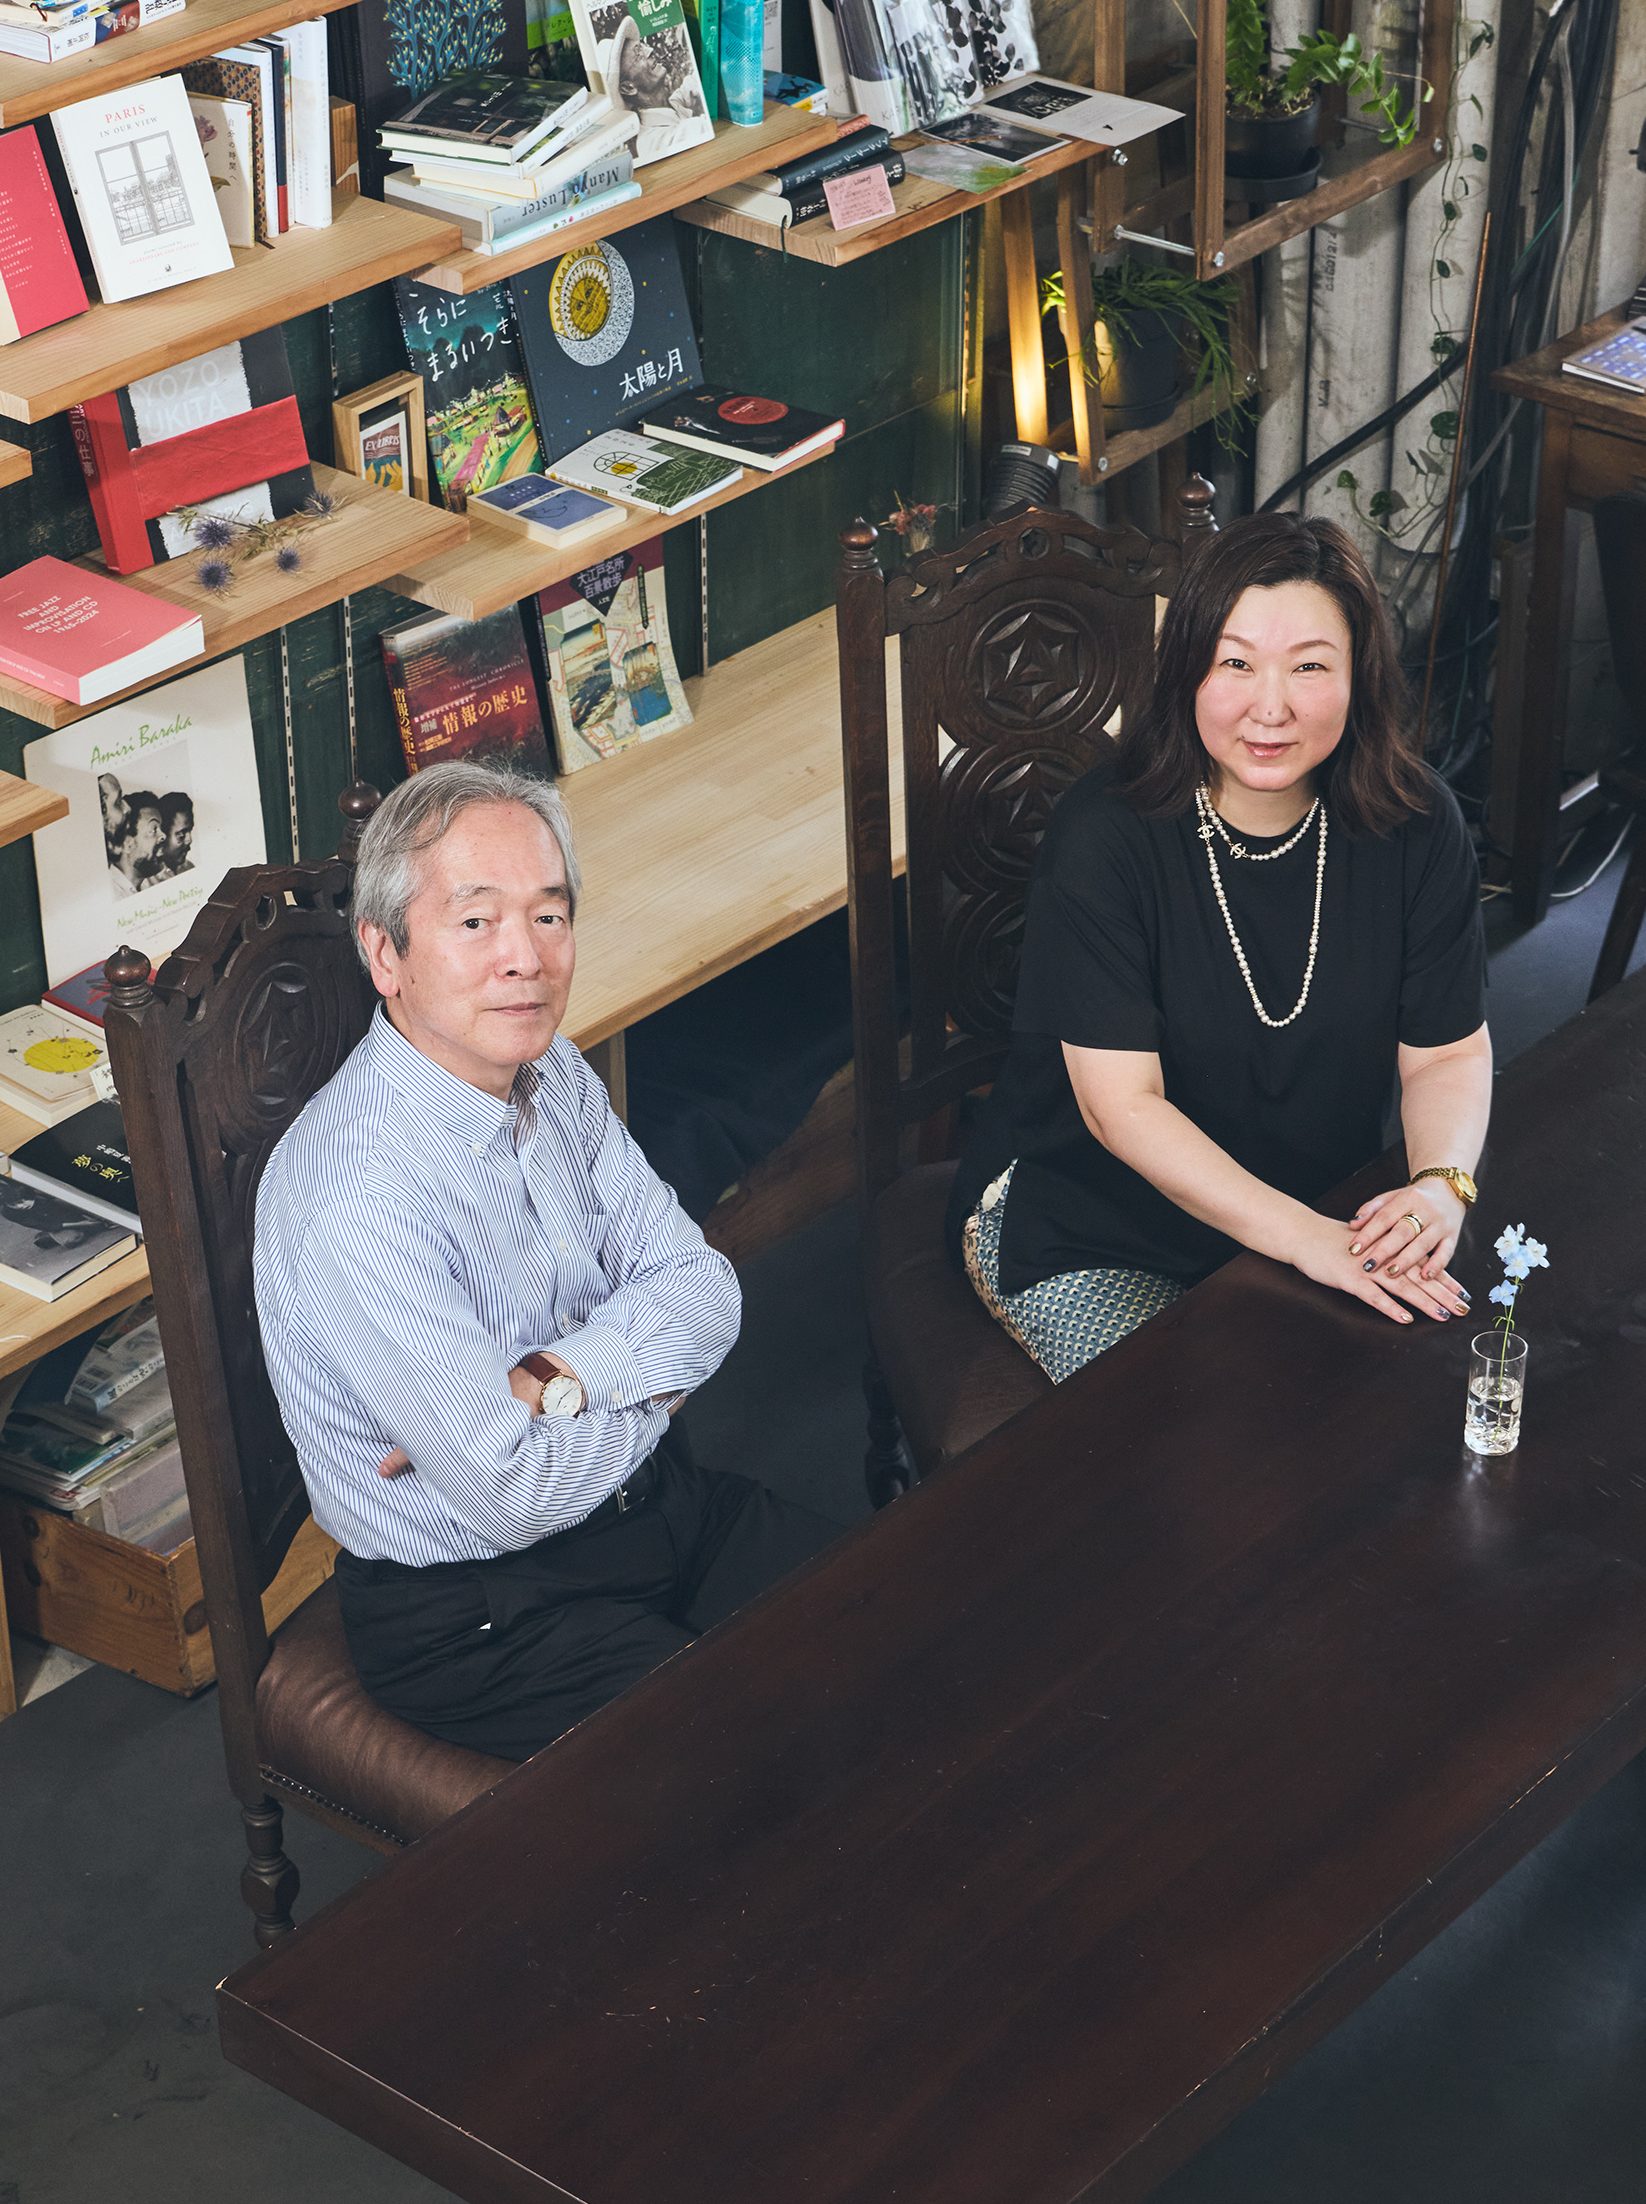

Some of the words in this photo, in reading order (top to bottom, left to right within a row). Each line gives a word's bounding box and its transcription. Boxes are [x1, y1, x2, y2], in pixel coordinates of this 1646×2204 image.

[99, 129, 110, 138] IN
[113, 123, 132, 134] OUR
[135, 116, 158, 127] VIEW
[104, 103, 146, 124] PARIS
[521, 188, 567, 217] Luster
[412, 296, 467, 335] そらに
[427, 316, 512, 382] まるいつき
[619, 347, 684, 401] 太陽と月
[365, 440, 377, 452] EX
[376, 434, 401, 449] LIBRIS
[576, 555, 625, 588] 大江戸名所
[23, 595, 92, 632] IMPROVISATION
[35, 625, 52, 634] ON
[63, 609, 83, 623] AND
[82, 600, 98, 611] CD
[39, 605, 60, 617] AND
[40, 595, 61, 609] JAZZ
[393, 687, 416, 755] 情報の歴史
[442, 684, 528, 735] 情報の歴史
[90, 736, 135, 770] Amiri
[138, 713, 193, 748] Baraka
